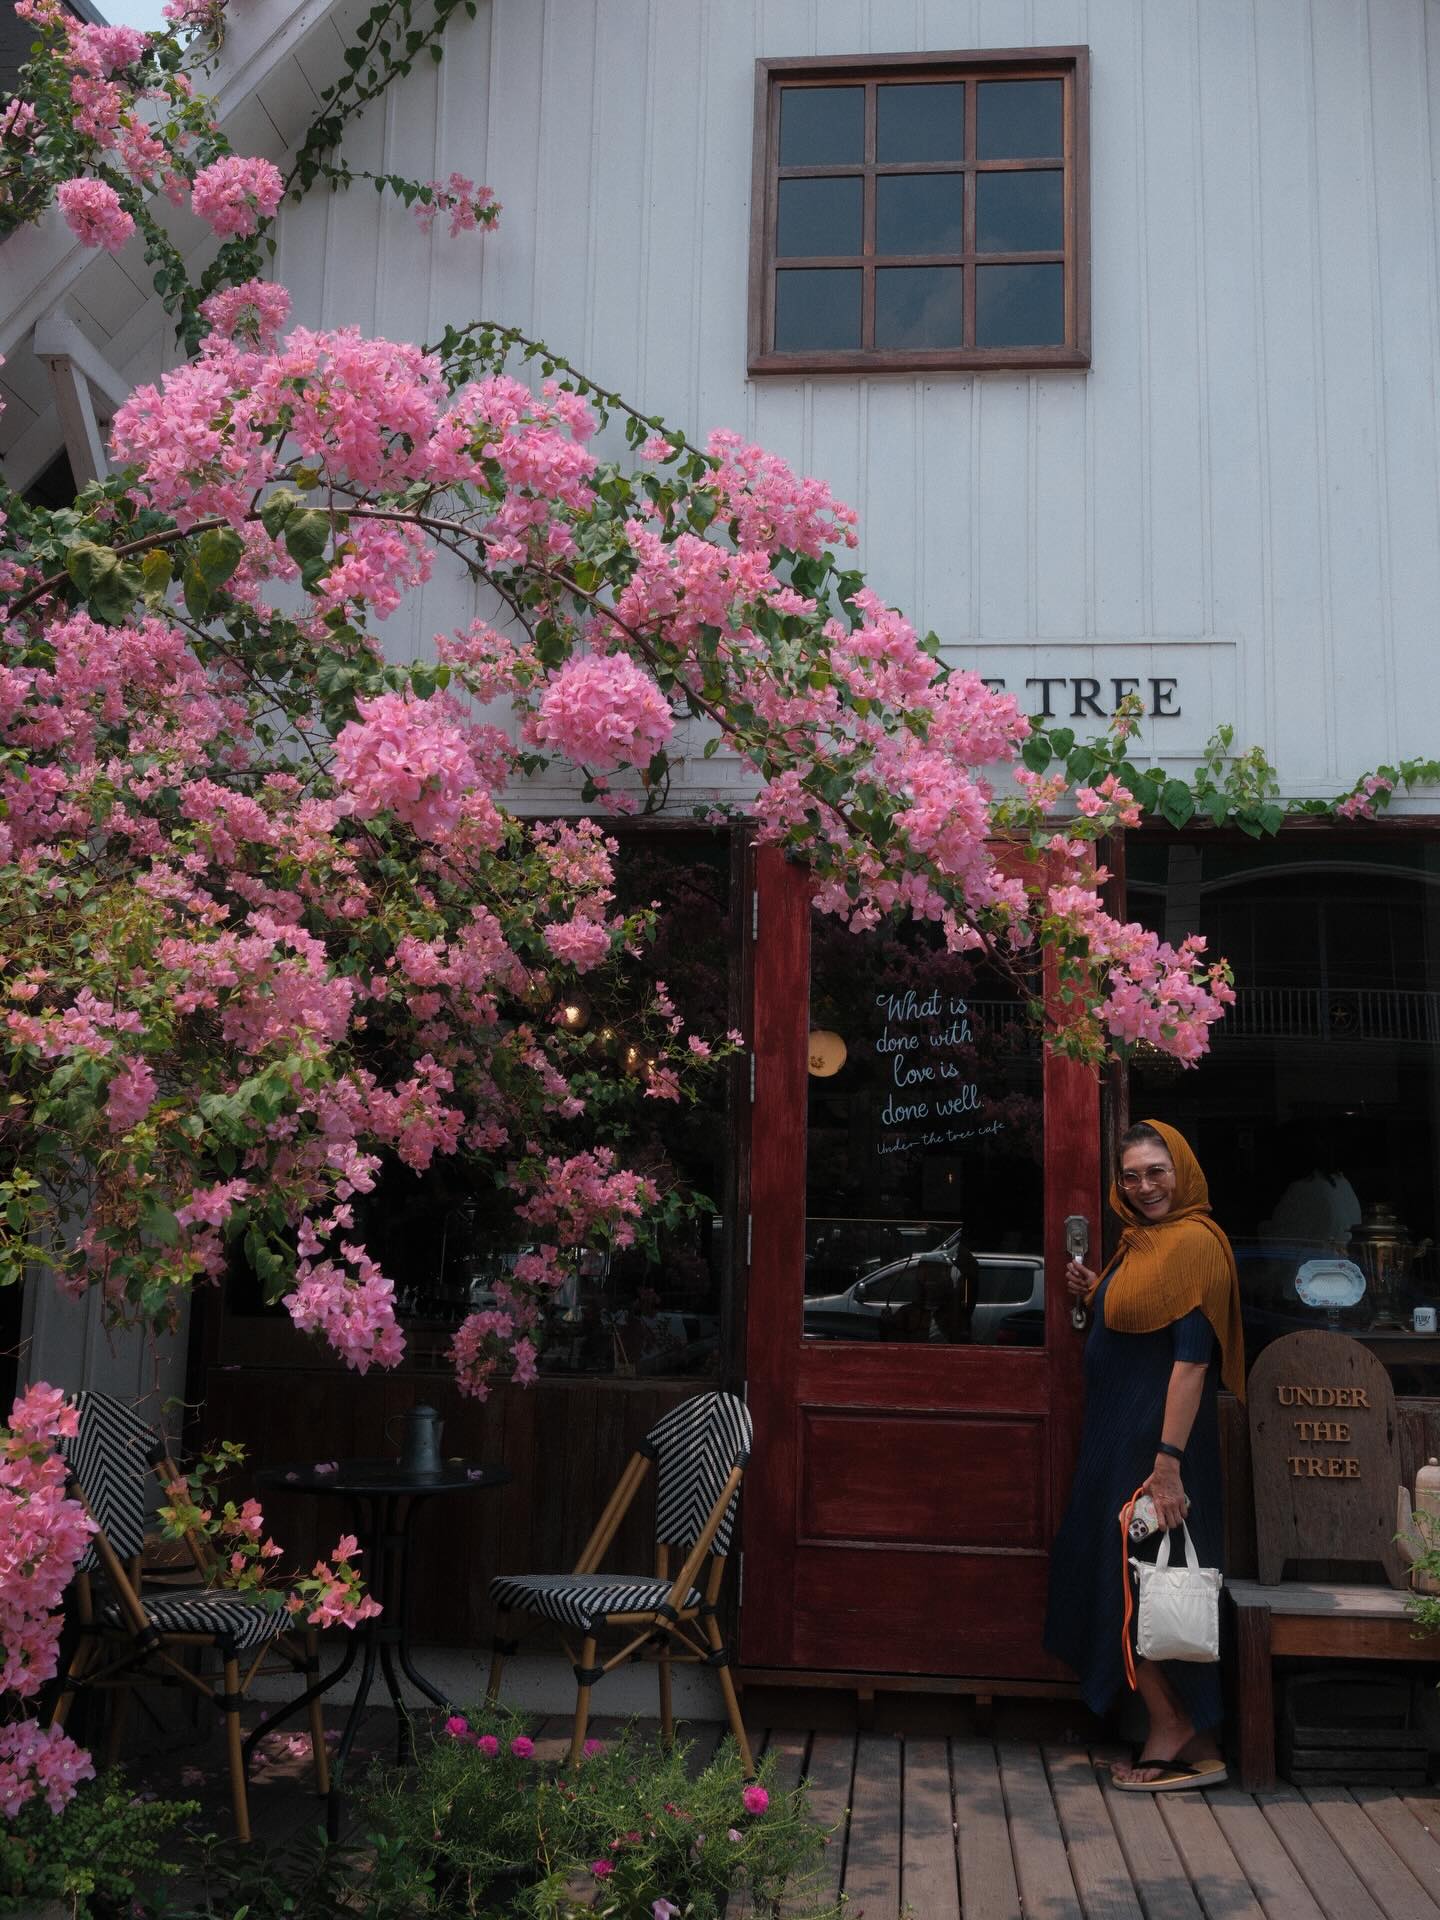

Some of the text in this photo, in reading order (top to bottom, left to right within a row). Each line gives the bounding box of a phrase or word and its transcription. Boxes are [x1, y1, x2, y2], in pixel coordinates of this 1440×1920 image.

[1025, 678, 1182, 717] TREE
[876, 989, 967, 1021] What is
[876, 1019, 973, 1053] done with
[940, 1062, 959, 1078] is
[881, 1083, 985, 1125] done well.
[921, 1132, 944, 1145] the
[946, 1129, 975, 1142] tree
[1276, 1385, 1371, 1408] UNDER
[1293, 1419, 1351, 1442] THE
[1287, 1456, 1361, 1478] TREE
